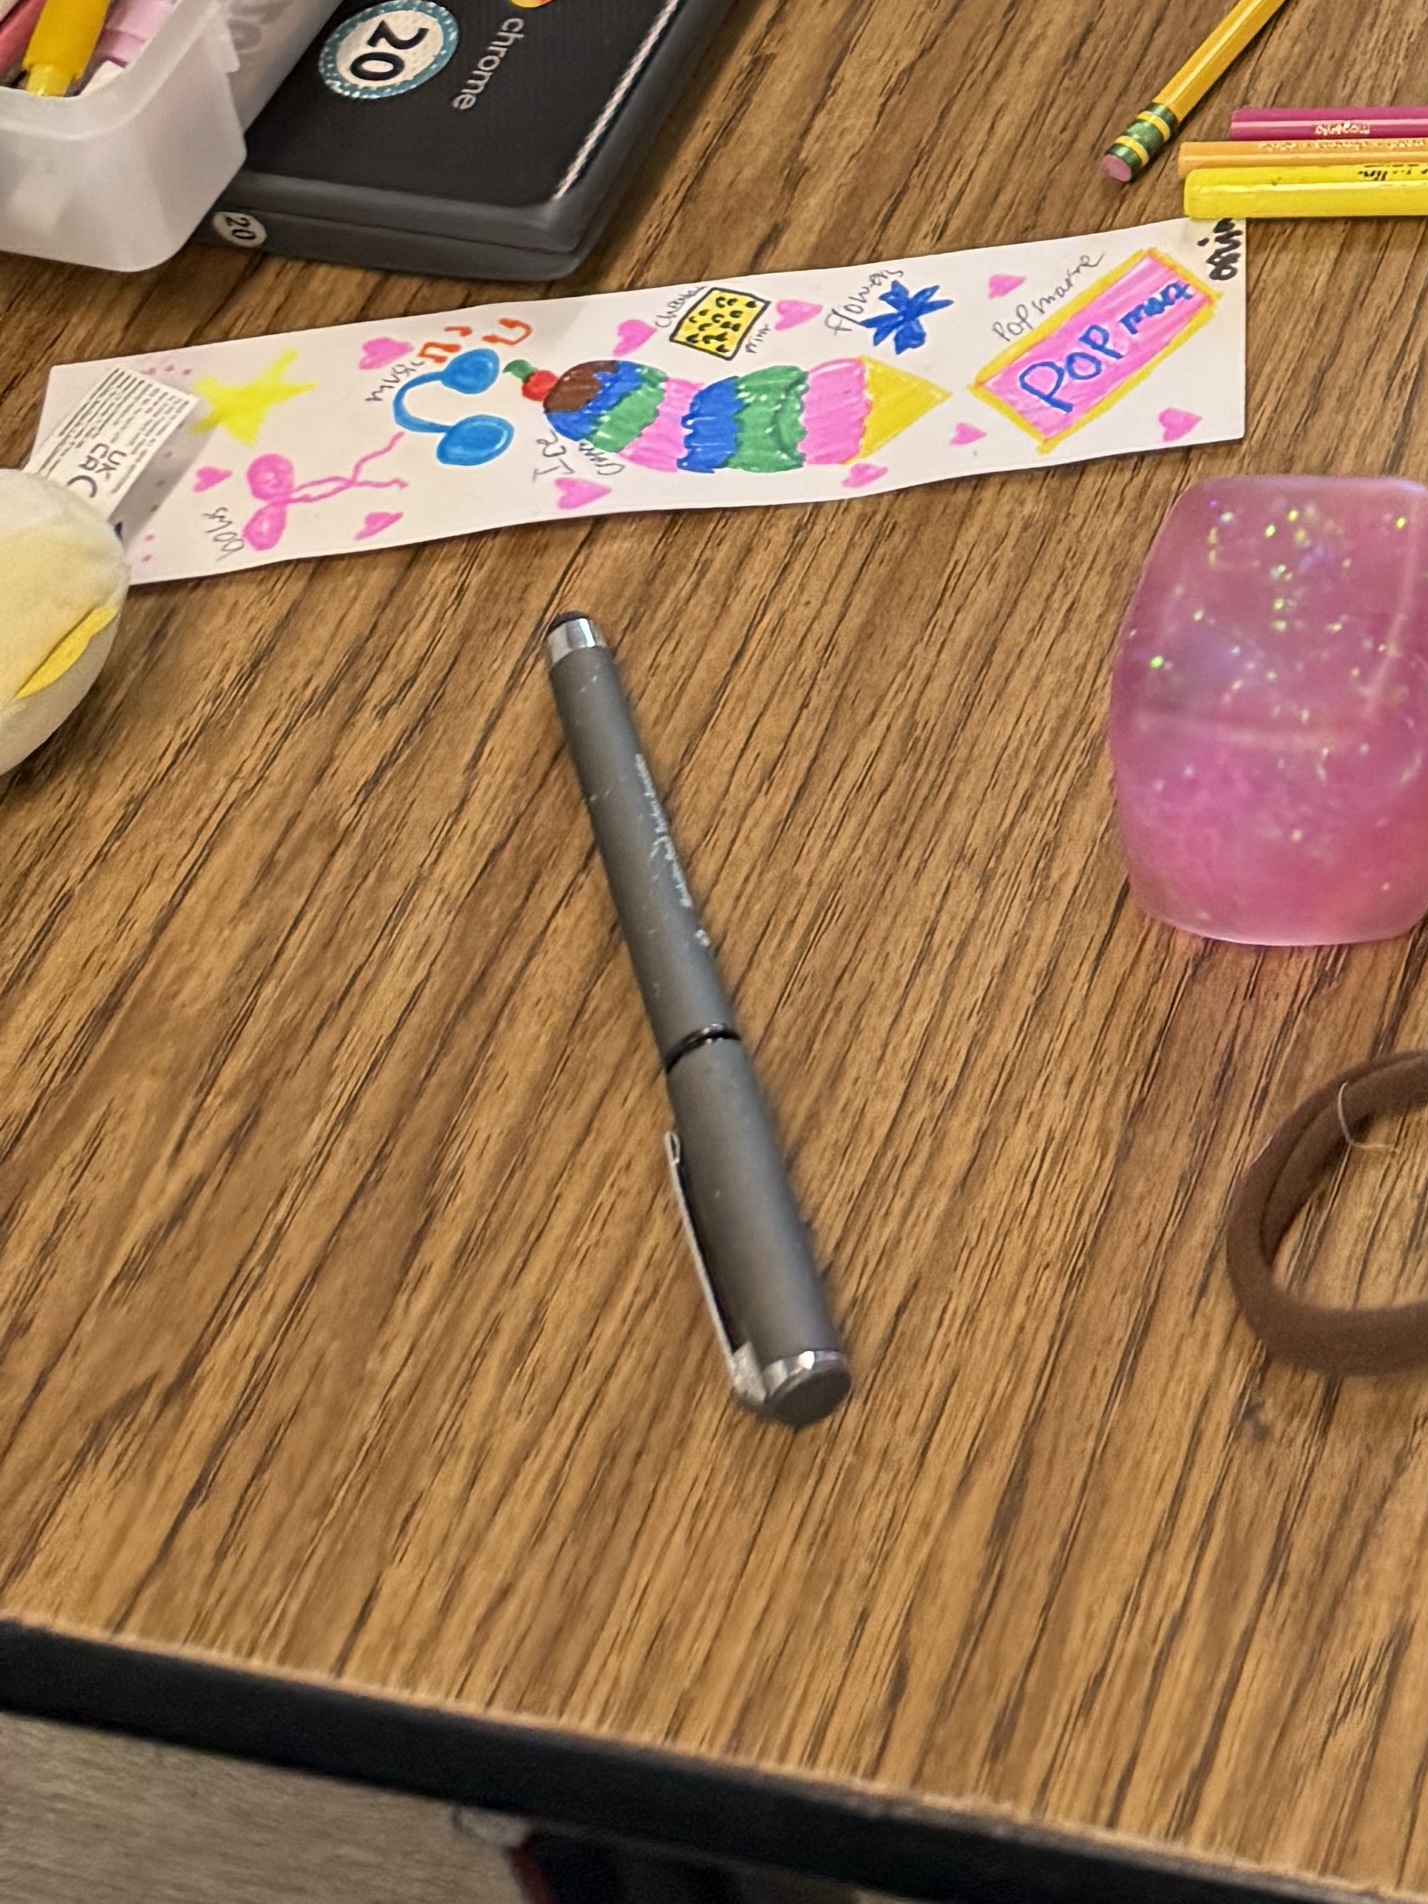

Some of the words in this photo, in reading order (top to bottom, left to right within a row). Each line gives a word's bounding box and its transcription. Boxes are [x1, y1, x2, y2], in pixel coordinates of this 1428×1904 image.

[347, 18, 431, 86] 20
[450, 12, 526, 112] chrome
[224, 212, 258, 245] 20
